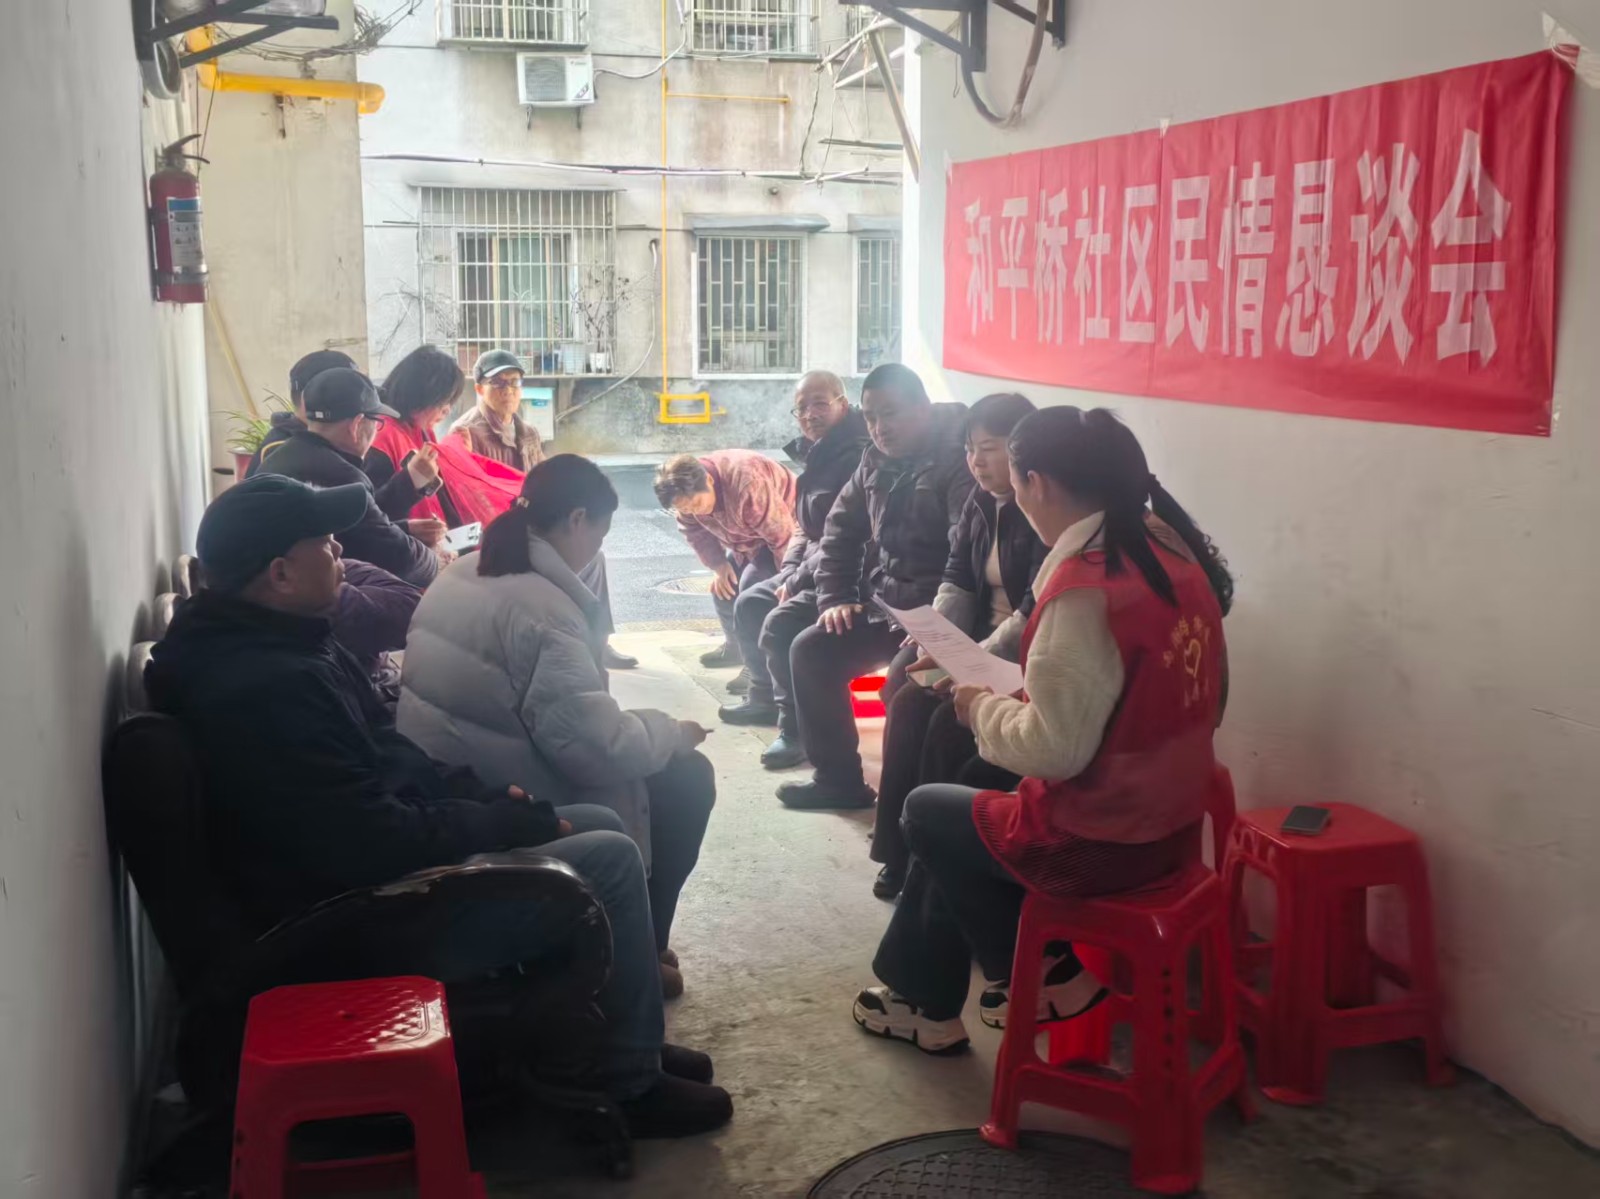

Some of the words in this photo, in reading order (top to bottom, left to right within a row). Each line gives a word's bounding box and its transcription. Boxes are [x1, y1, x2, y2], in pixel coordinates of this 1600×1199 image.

[964, 130, 1512, 366] 和平桥社区民情恳谈会
